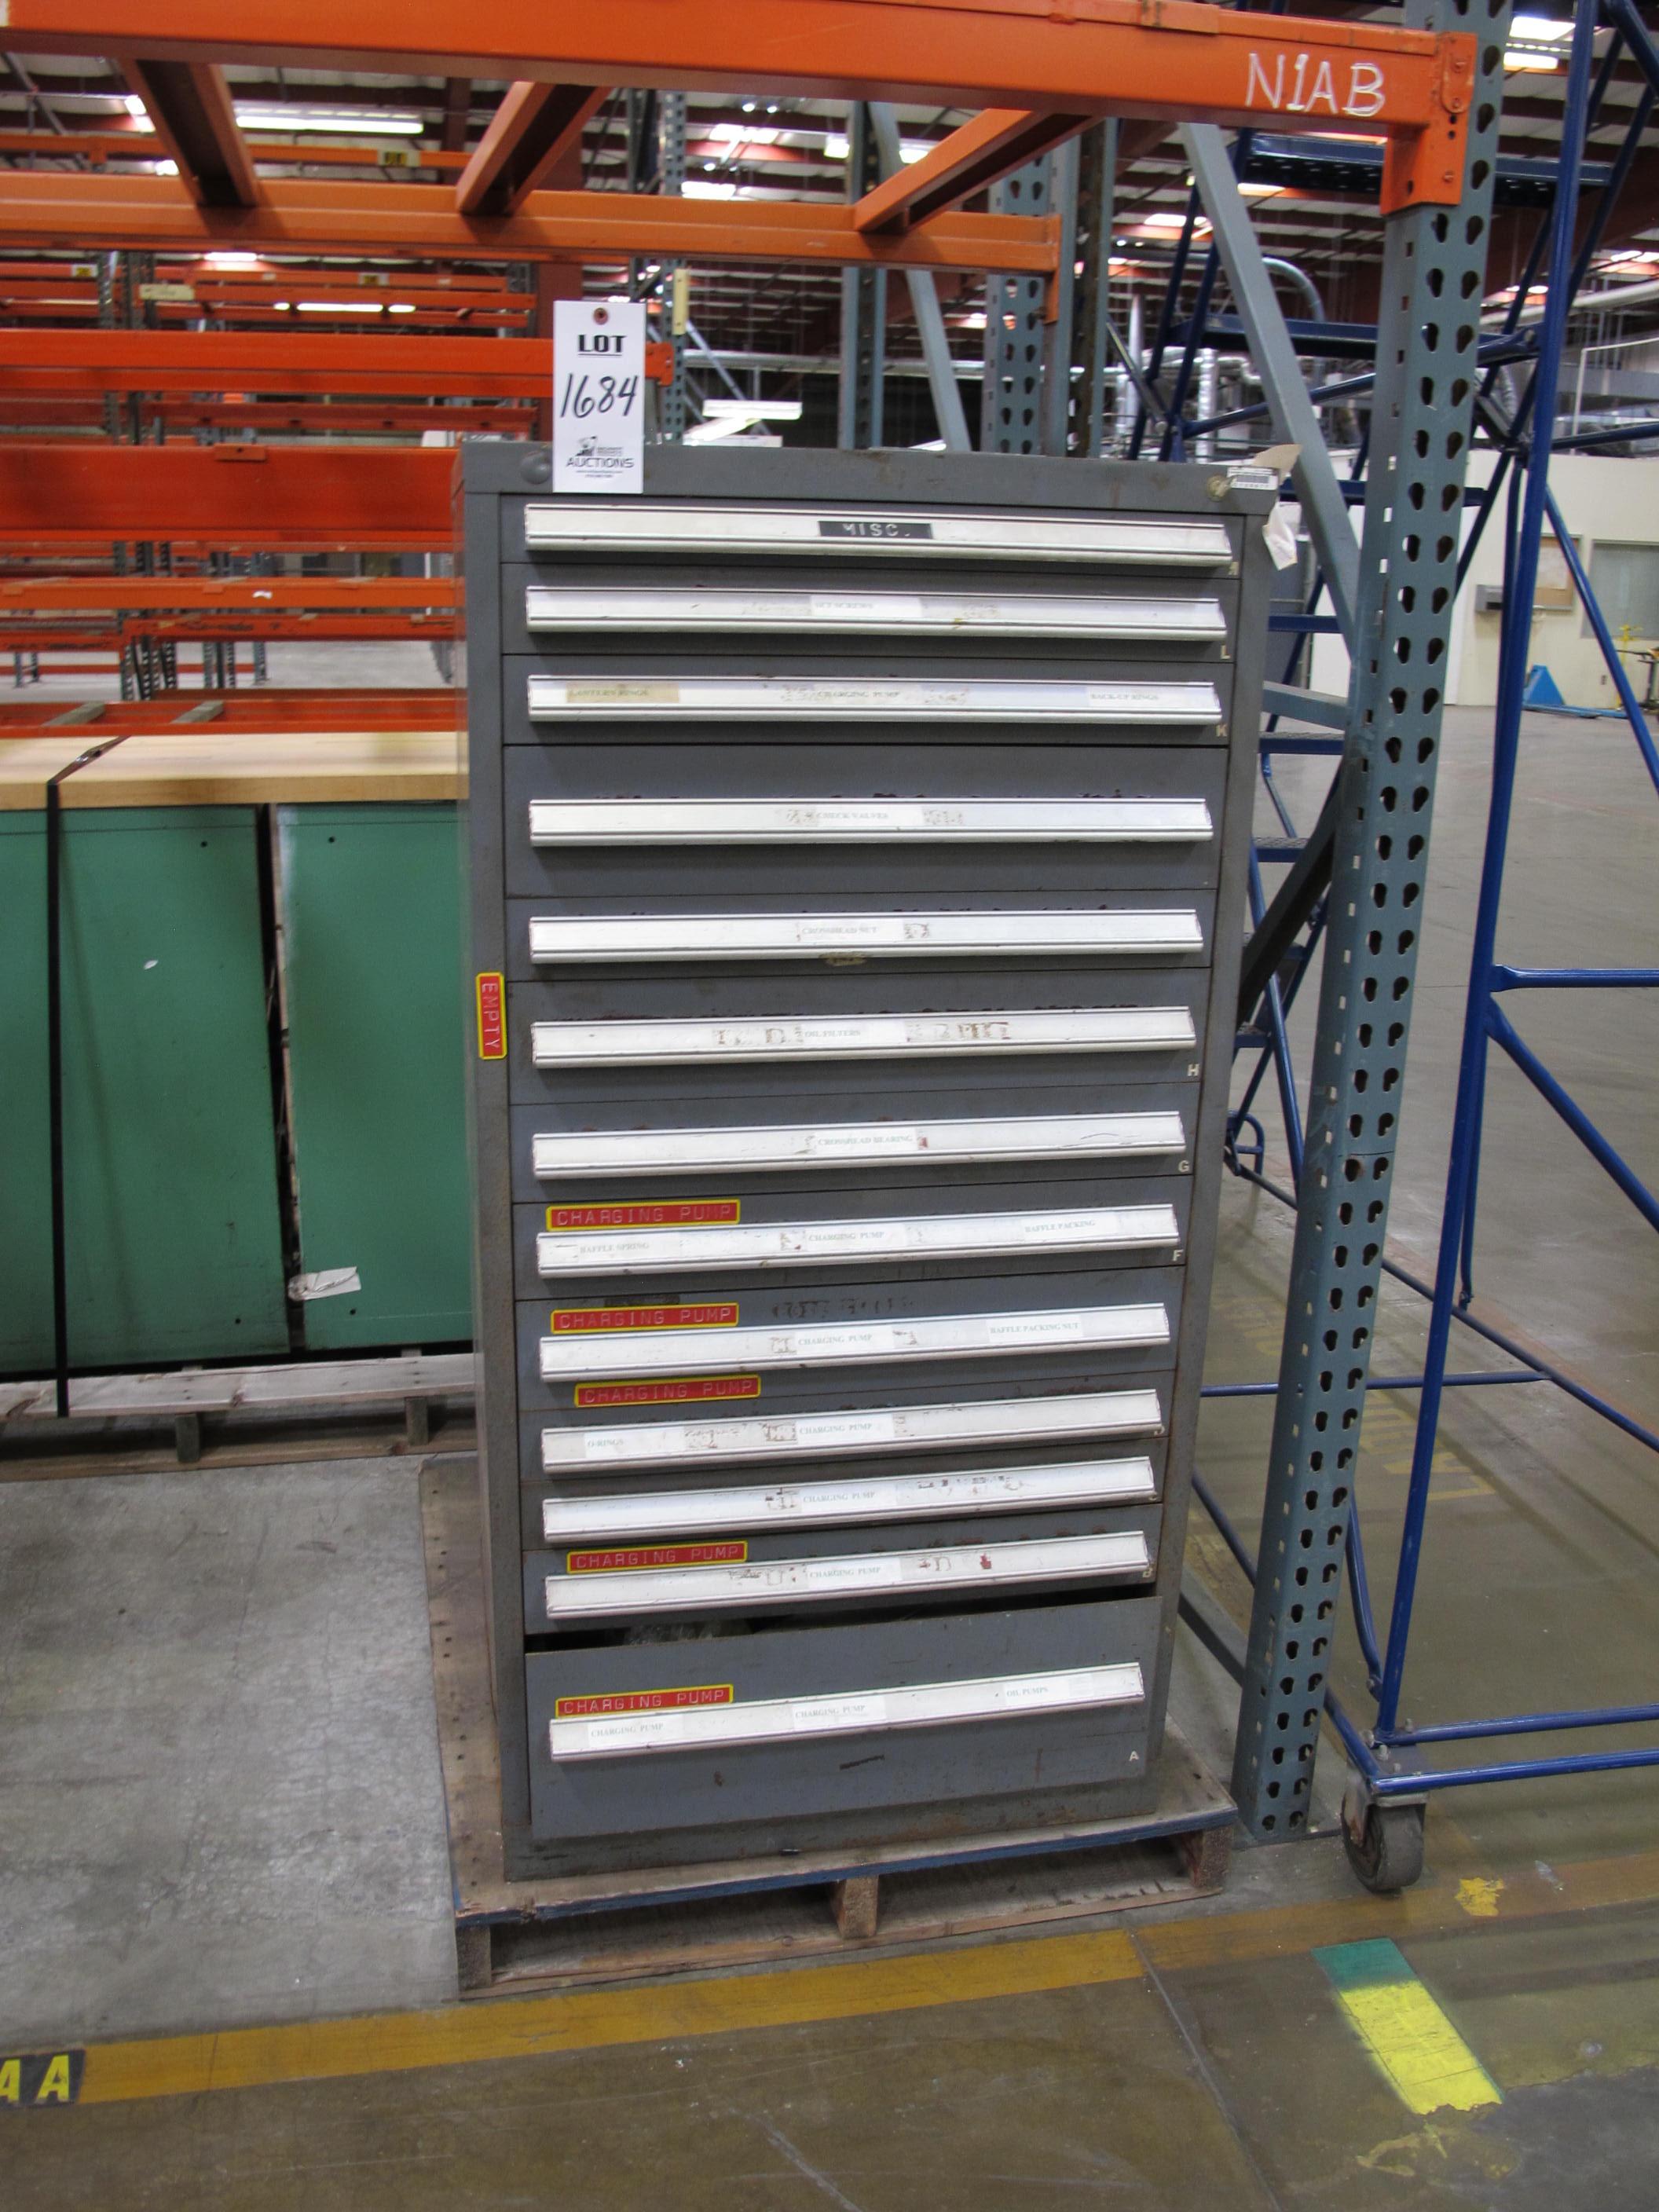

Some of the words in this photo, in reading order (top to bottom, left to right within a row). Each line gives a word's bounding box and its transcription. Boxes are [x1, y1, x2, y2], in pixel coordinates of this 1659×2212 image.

[578, 335, 627, 353] LOT
[560, 372, 639, 419] 1684
[566, 457, 635, 468] AUCTIONS
[1221, 645, 1231, 659] L
[482, 983, 500, 1049] EMPTY
[1188, 1064, 1200, 1076] H
[818, 1137, 871, 1145] CROSSHEAD
[1178, 1159, 1190, 1173] G
[557, 1207, 664, 1225] CHARGING
[679, 1204, 731, 1221] PUMP
[1024, 1224, 1056, 1233] BAFFLE
[1057, 1220, 1096, 1230] PACKING
[808, 1232, 856, 1242] CHARGING
[859, 1231, 884, 1240] PUMP
[580, 1244, 615, 1254] BAFFLE
[616, 1243, 650, 1252] SPRING
[1172, 1249, 1183, 1262] F
[559, 1310, 665, 1328] CHARGING
[680, 1307, 731, 1324] PUMP
[991, 1325, 1021, 1335] BAFFLE
[1023, 1324, 1061, 1333] PACKING
[1062, 1322, 1080, 1331] NUT
[798, 1336, 844, 1346] CHARGING
[848, 1334, 873, 1342] PUMP
[584, 1383, 688, 1403] CHARGING
[702, 1379, 753, 1396] PUMP
[799, 1425, 845, 1435] CHARGING
[848, 1423, 873, 1432] PUMP
[803, 1493, 848, 1504] CHARGING
[851, 1491, 875, 1500] PUMP
[576, 1549, 676, 1569] CHARGING
[690, 1545, 739, 1561] PUMP
[809, 1569, 854, 1579] CHARGING
[857, 1566, 881, 1575] PUMP
[1006, 1689, 1021, 1697] OIL
[1023, 1686, 1049, 1695] PUMPS
[564, 1694, 662, 1714] CHARGING
[676, 1689, 724, 1705] PUMP
[795, 1708, 840, 1719] CHARGING
[842, 1705, 866, 1714] PUMP
[591, 1726, 636, 1738] CHARGING
[640, 1723, 664, 1733] PUMP
[1129, 1750, 1139, 1761] A
